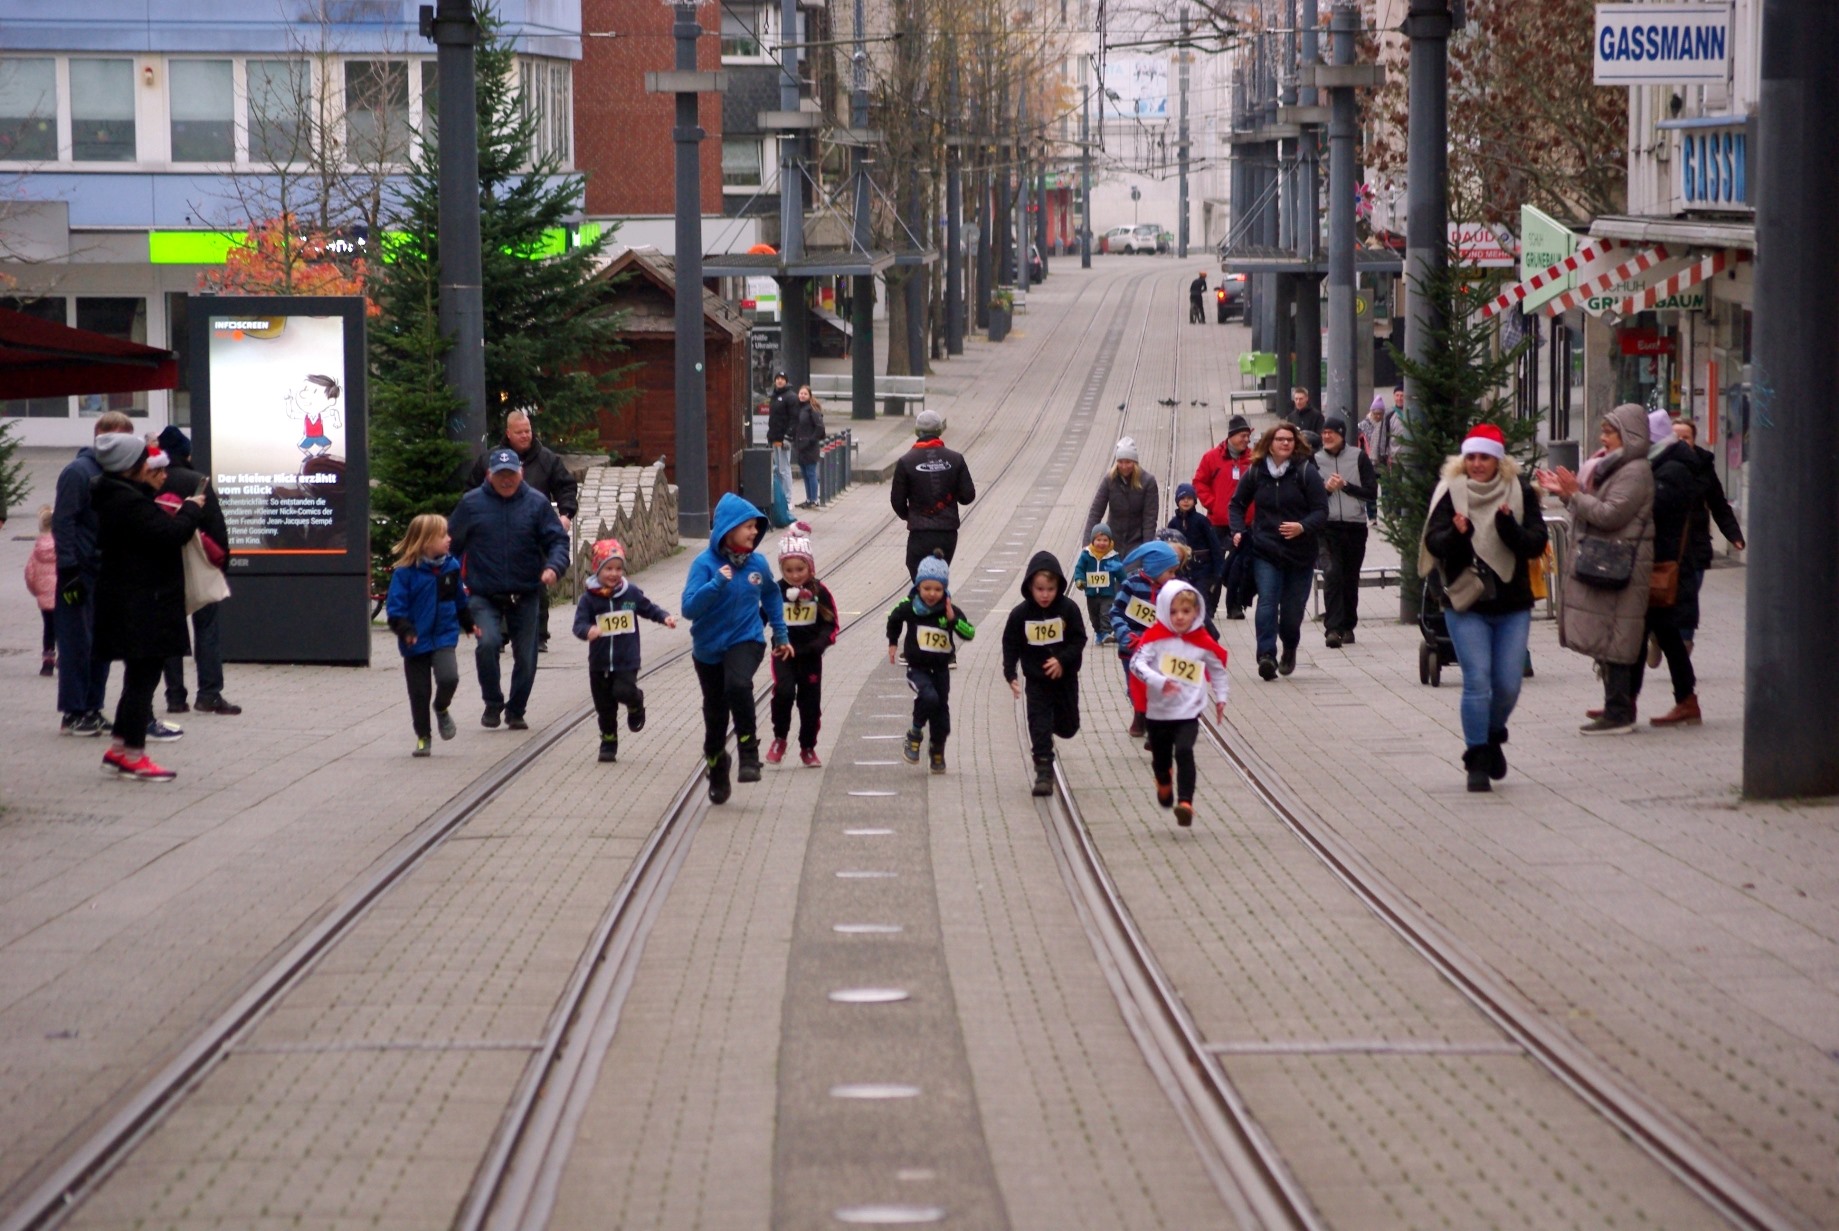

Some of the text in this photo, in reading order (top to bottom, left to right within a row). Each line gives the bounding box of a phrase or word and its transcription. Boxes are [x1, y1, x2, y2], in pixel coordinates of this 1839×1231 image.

[1600, 25, 1725, 61] GASSMANN
[214, 321, 269, 330] INFOSCREEN
[217, 472, 337, 483] Der kleine Nick erzählt
[243, 485, 272, 495] Glück
[270, 498, 279, 506] So
[280, 498, 315, 506] entstanden
[315, 498, 326, 506] die
[322, 507, 333, 515] der
[240, 517, 266, 525] Freunde
[267, 517, 310, 526] Jean-Jacques
[310, 517, 333, 526] Sempé
[232, 527, 248, 535] René
[249, 527, 279, 536] Goscinny.
[236, 537, 244, 545] im
[245, 537, 261, 545] Kino.
[1090, 575, 1106, 584] 199
[786, 607, 811, 621] 197
[1135, 603, 1156, 622] 195
[604, 616, 628, 631] 198
[1034, 624, 1056, 641] 196
[924, 632, 948, 648] 193
[1170, 658, 1196, 681] 192
